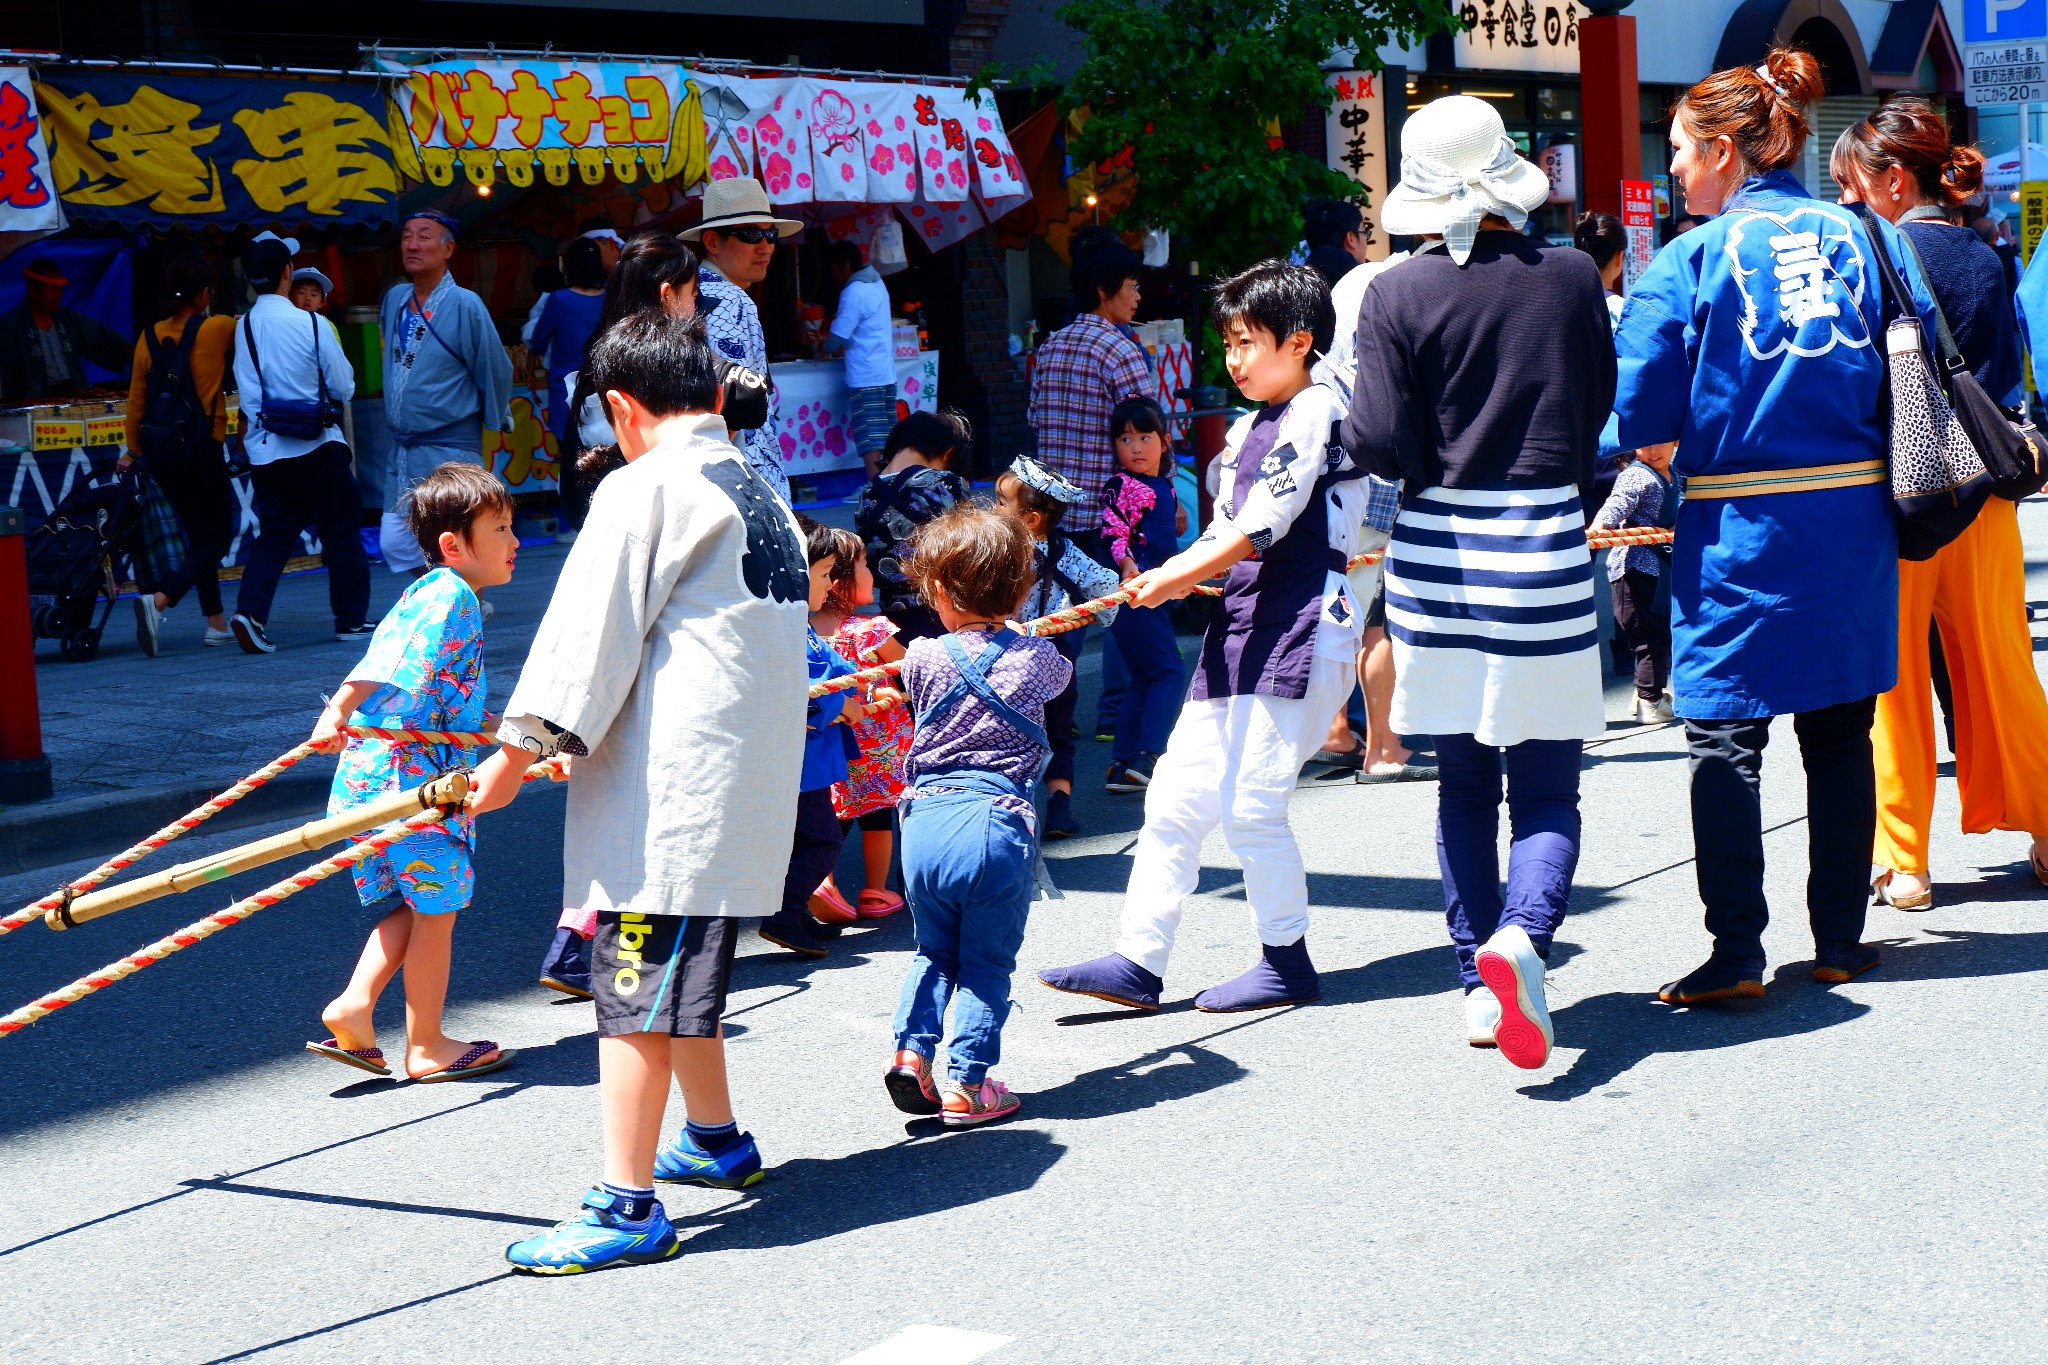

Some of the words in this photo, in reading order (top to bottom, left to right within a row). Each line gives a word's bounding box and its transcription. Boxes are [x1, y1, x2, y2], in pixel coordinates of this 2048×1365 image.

[1460, 0, 1538, 50] 中華食堂
[1335, 75, 1375, 102] 熱烈
[1973, 66, 2041, 84] 駐車方法表示線内
[411, 70, 671, 147] バナナチョコ
[1976, 85, 2040, 103] ここから20m
[922, 361, 937, 403] 浅草
